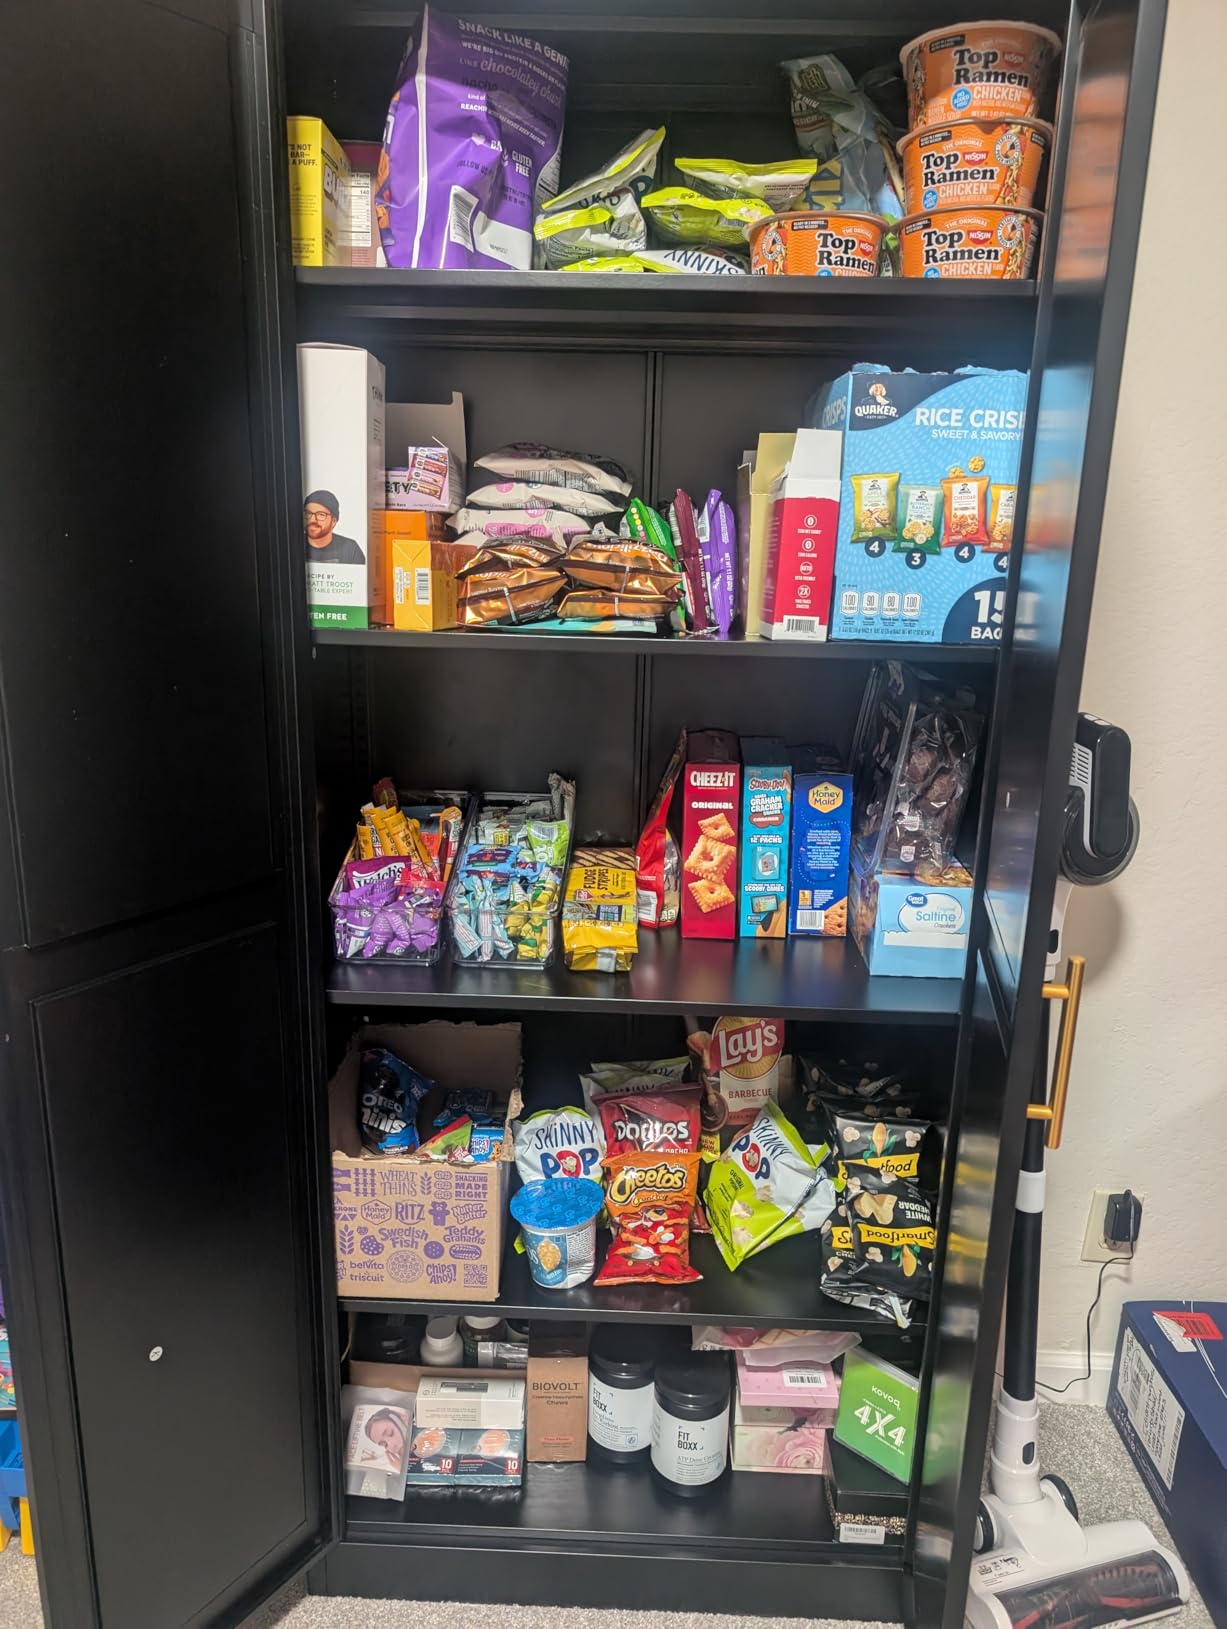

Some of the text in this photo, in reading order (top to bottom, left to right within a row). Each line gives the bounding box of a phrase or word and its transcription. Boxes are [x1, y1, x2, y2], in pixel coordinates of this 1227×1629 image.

[458, 19, 501, 41] SNACK
[503, 33, 532, 49] LIKE
[534, 41, 542, 52] A
[953, 48, 999, 69] Top
[480, 56, 540, 96] chocolatey
[953, 68, 1029, 88] Ramen
[973, 87, 1022, 102] CHICKEN
[943, 142, 954, 151] THE
[954, 139, 983, 148] ORIGINAL
[512, 150, 533, 168] GLUTEN
[922, 151, 959, 171] Top
[964, 152, 987, 161] NISSIN
[515, 163, 529, 177] FREE
[922, 168, 996, 188] Ramen
[939, 182, 988, 198] CHICKEN
[958, 218, 988, 227] ORIGINAL
[922, 230, 963, 249] Top
[969, 231, 992, 240] NISSIN
[816, 232, 857, 255] Top
[817, 249, 876, 274] Ramen
[923, 247, 1001, 265] Ramen
[941, 263, 992, 276] CHICKEN
[822, 396, 848, 427] CRISPS
[854, 404, 897, 417] QUAKER
[915, 407, 964, 427] RICE
[931, 429, 1021, 441] SWEET & SAVORY
[870, 542, 880, 552] 4
[959, 547, 969, 559] 4
[911, 554, 921, 565] 3
[998, 558, 1007, 568] 4
[322, 581, 354, 589] TROOST
[845, 594, 856, 606] 100
[906, 597, 918, 608] 100
[327, 613, 348, 621] FREE
[970, 627, 1002, 640] BAG
[750, 796, 782, 806] GRAHAM
[811, 789, 841, 801] Honey
[691, 801, 733, 810] ORIGINAL
[751, 803, 783, 813] CRACKER
[814, 798, 836, 806] Maid
[583, 868, 597, 889] FUDGE
[597, 868, 611, 891] STRIPES
[916, 911, 957, 922] Saltine
[718, 1020, 778, 1069] Lay's
[728, 1087, 773, 1100] BARBECUE
[361, 1093, 403, 1113] OREO
[540, 1147, 600, 1179] POP
[732, 1133, 771, 1180] POP
[880, 1159, 913, 1173] tfood
[379, 1170, 418, 1183] WHEAT
[454, 1174, 488, 1183] SNACKING
[610, 1163, 685, 1203] Cheetos
[454, 1183, 488, 1191] MADE
[455, 1191, 489, 1199] RIGHT
[363, 1206, 390, 1216] Honey
[395, 1202, 426, 1221] RITZ
[452, 1203, 484, 1217] Nutter
[898, 1200, 931, 1214] HEDDAR
[365, 1211, 386, 1220] Maid
[456, 1208, 488, 1225] Butter
[905, 1210, 932, 1223] WHITE
[378, 1227, 429, 1242] Swedish
[444, 1225, 485, 1237] Teddy
[867, 1229, 935, 1246] Smartfood
[391, 1236, 419, 1250] Fish
[443, 1234, 486, 1245] Grahams
[426, 1263, 451, 1275] Chips
[430, 1264, 457, 1285] Ahoy!
[349, 1272, 385, 1282] triscuit
[532, 1382, 579, 1391] BIOVOLT
[592, 1387, 601, 1400] FIT
[592, 1396, 608, 1413] BOXX
[854, 1405, 907, 1447] 4X4
[678, 1431, 690, 1441] FIT
[677, 1440, 698, 1450] BOXX
[441, 1460, 452, 1468] 10
[507, 1460, 518, 1469] 10
